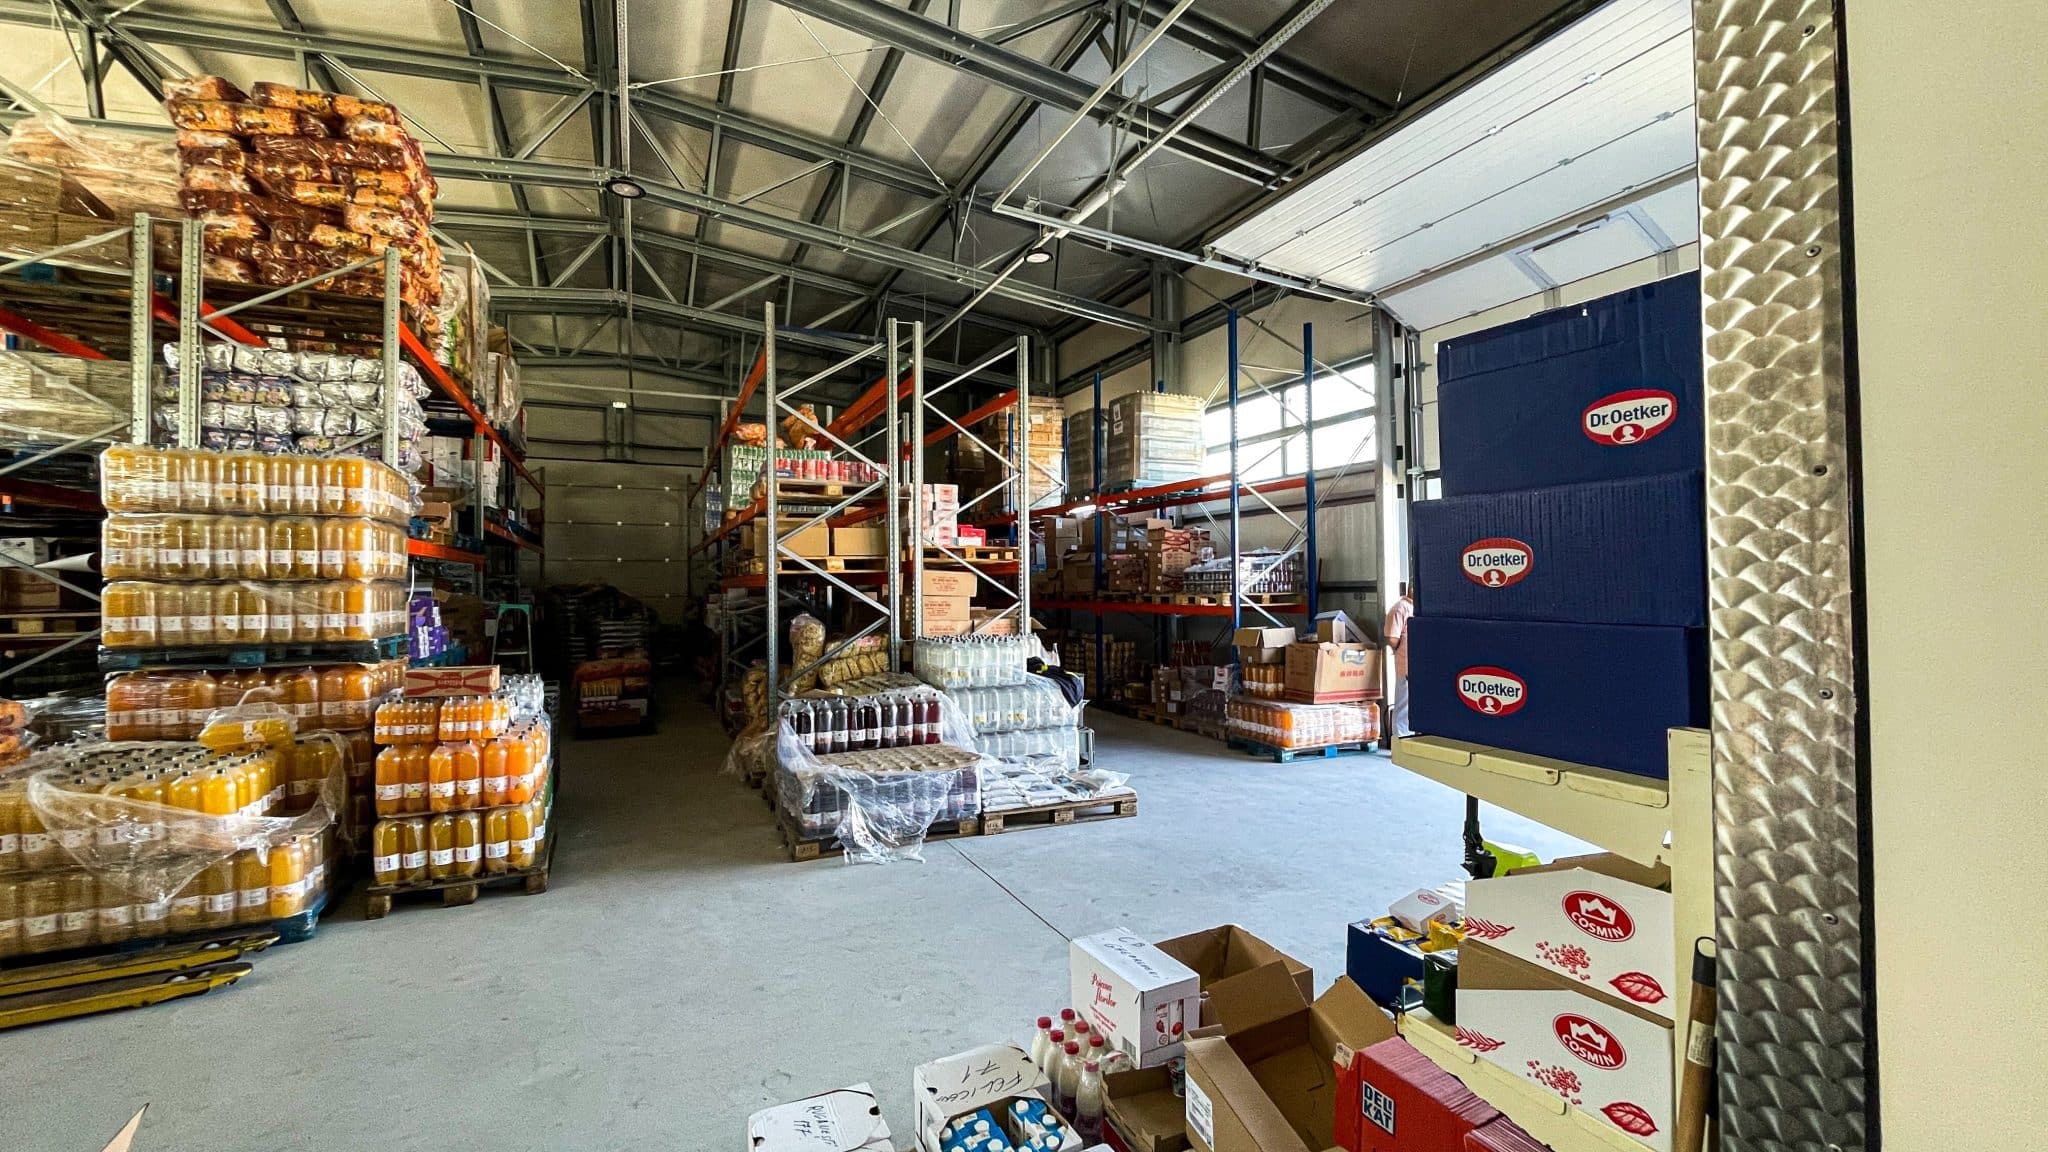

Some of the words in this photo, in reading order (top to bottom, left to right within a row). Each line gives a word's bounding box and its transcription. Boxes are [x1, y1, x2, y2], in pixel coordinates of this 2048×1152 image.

[1571, 911, 1625, 939] COSMIN
[1561, 1033, 1616, 1066] COSMIN
[1364, 1084, 1393, 1115] DELI
